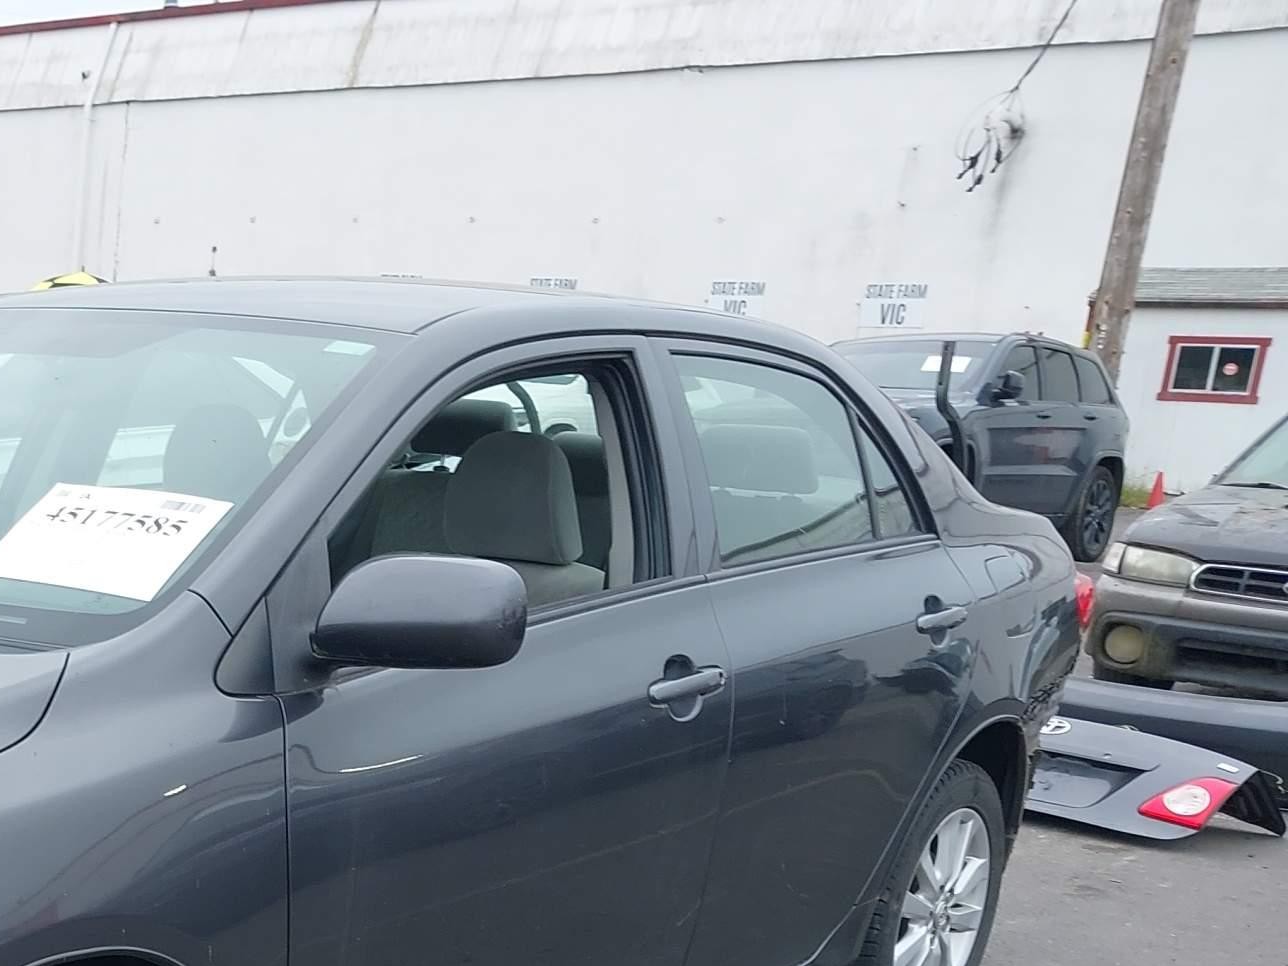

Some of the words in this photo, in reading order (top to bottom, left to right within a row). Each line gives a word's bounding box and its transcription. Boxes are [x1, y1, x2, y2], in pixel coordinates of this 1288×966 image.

[711, 281, 737, 296] STATE
[737, 281, 766, 296] FARM
[865, 283, 895, 299] STATE
[896, 283, 929, 299] FARM
[723, 299, 748, 316] VIC
[880, 303, 907, 325] VIC
[46, 506, 189, 536] 45177585
